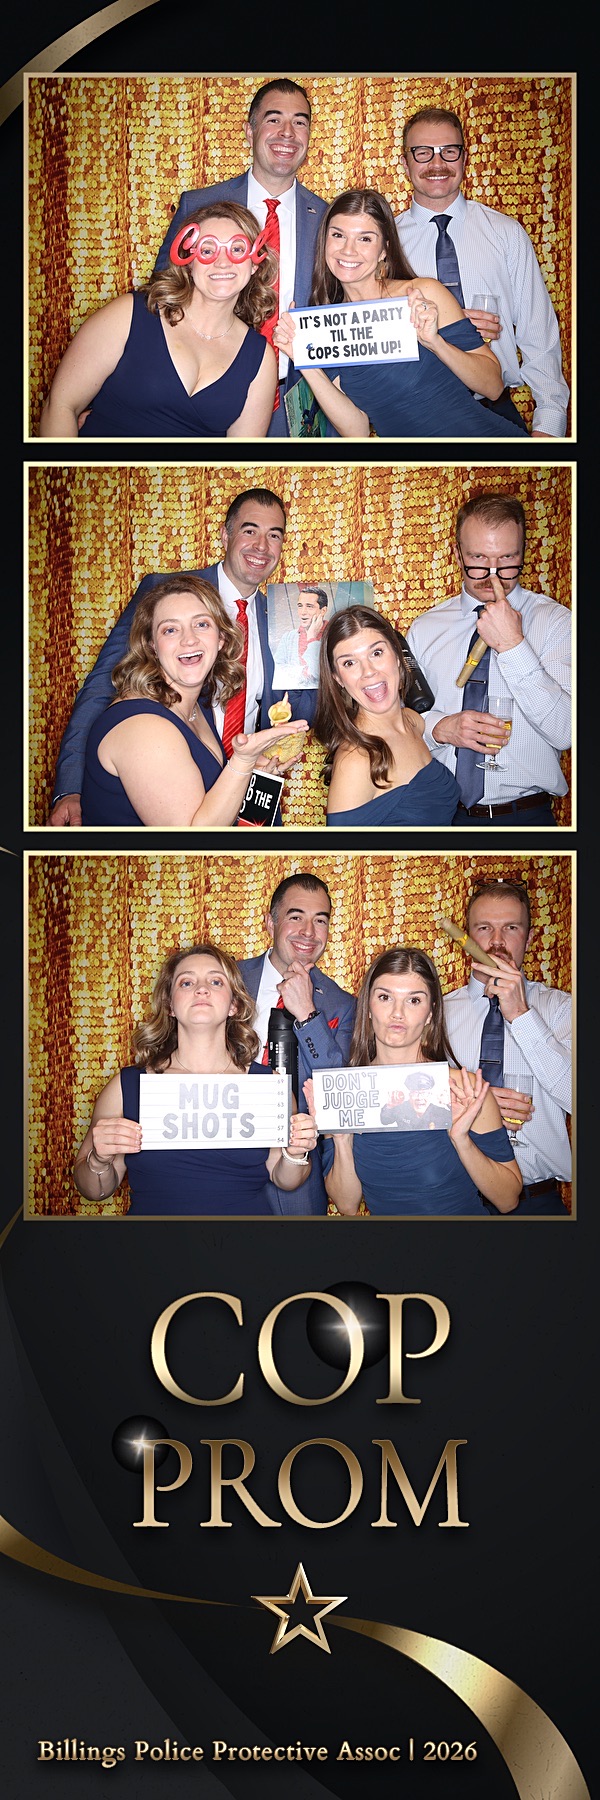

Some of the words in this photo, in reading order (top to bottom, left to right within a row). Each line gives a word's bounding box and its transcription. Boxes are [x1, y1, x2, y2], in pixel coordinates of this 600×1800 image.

[170, 222, 271, 266] Cool
[299, 315, 321, 329] IT'S
[323, 312, 348, 327] NOT
[351, 311, 360, 325] A
[362, 307, 403, 323] PARTY
[330, 329, 347, 342] TIL
[350, 326, 373, 340] THE
[307, 346, 339, 360] COPS
[343, 342, 378, 358] SHOW
[381, 340, 402, 354] UP!
[254, 789, 273, 810] THE
[322, 1072, 378, 1092] DON'T
[178, 1083, 240, 1110] MUG
[322, 1090, 381, 1110] JUDGE
[162, 1112, 256, 1140] SHOTS
[338, 1109, 366, 1127] ME
